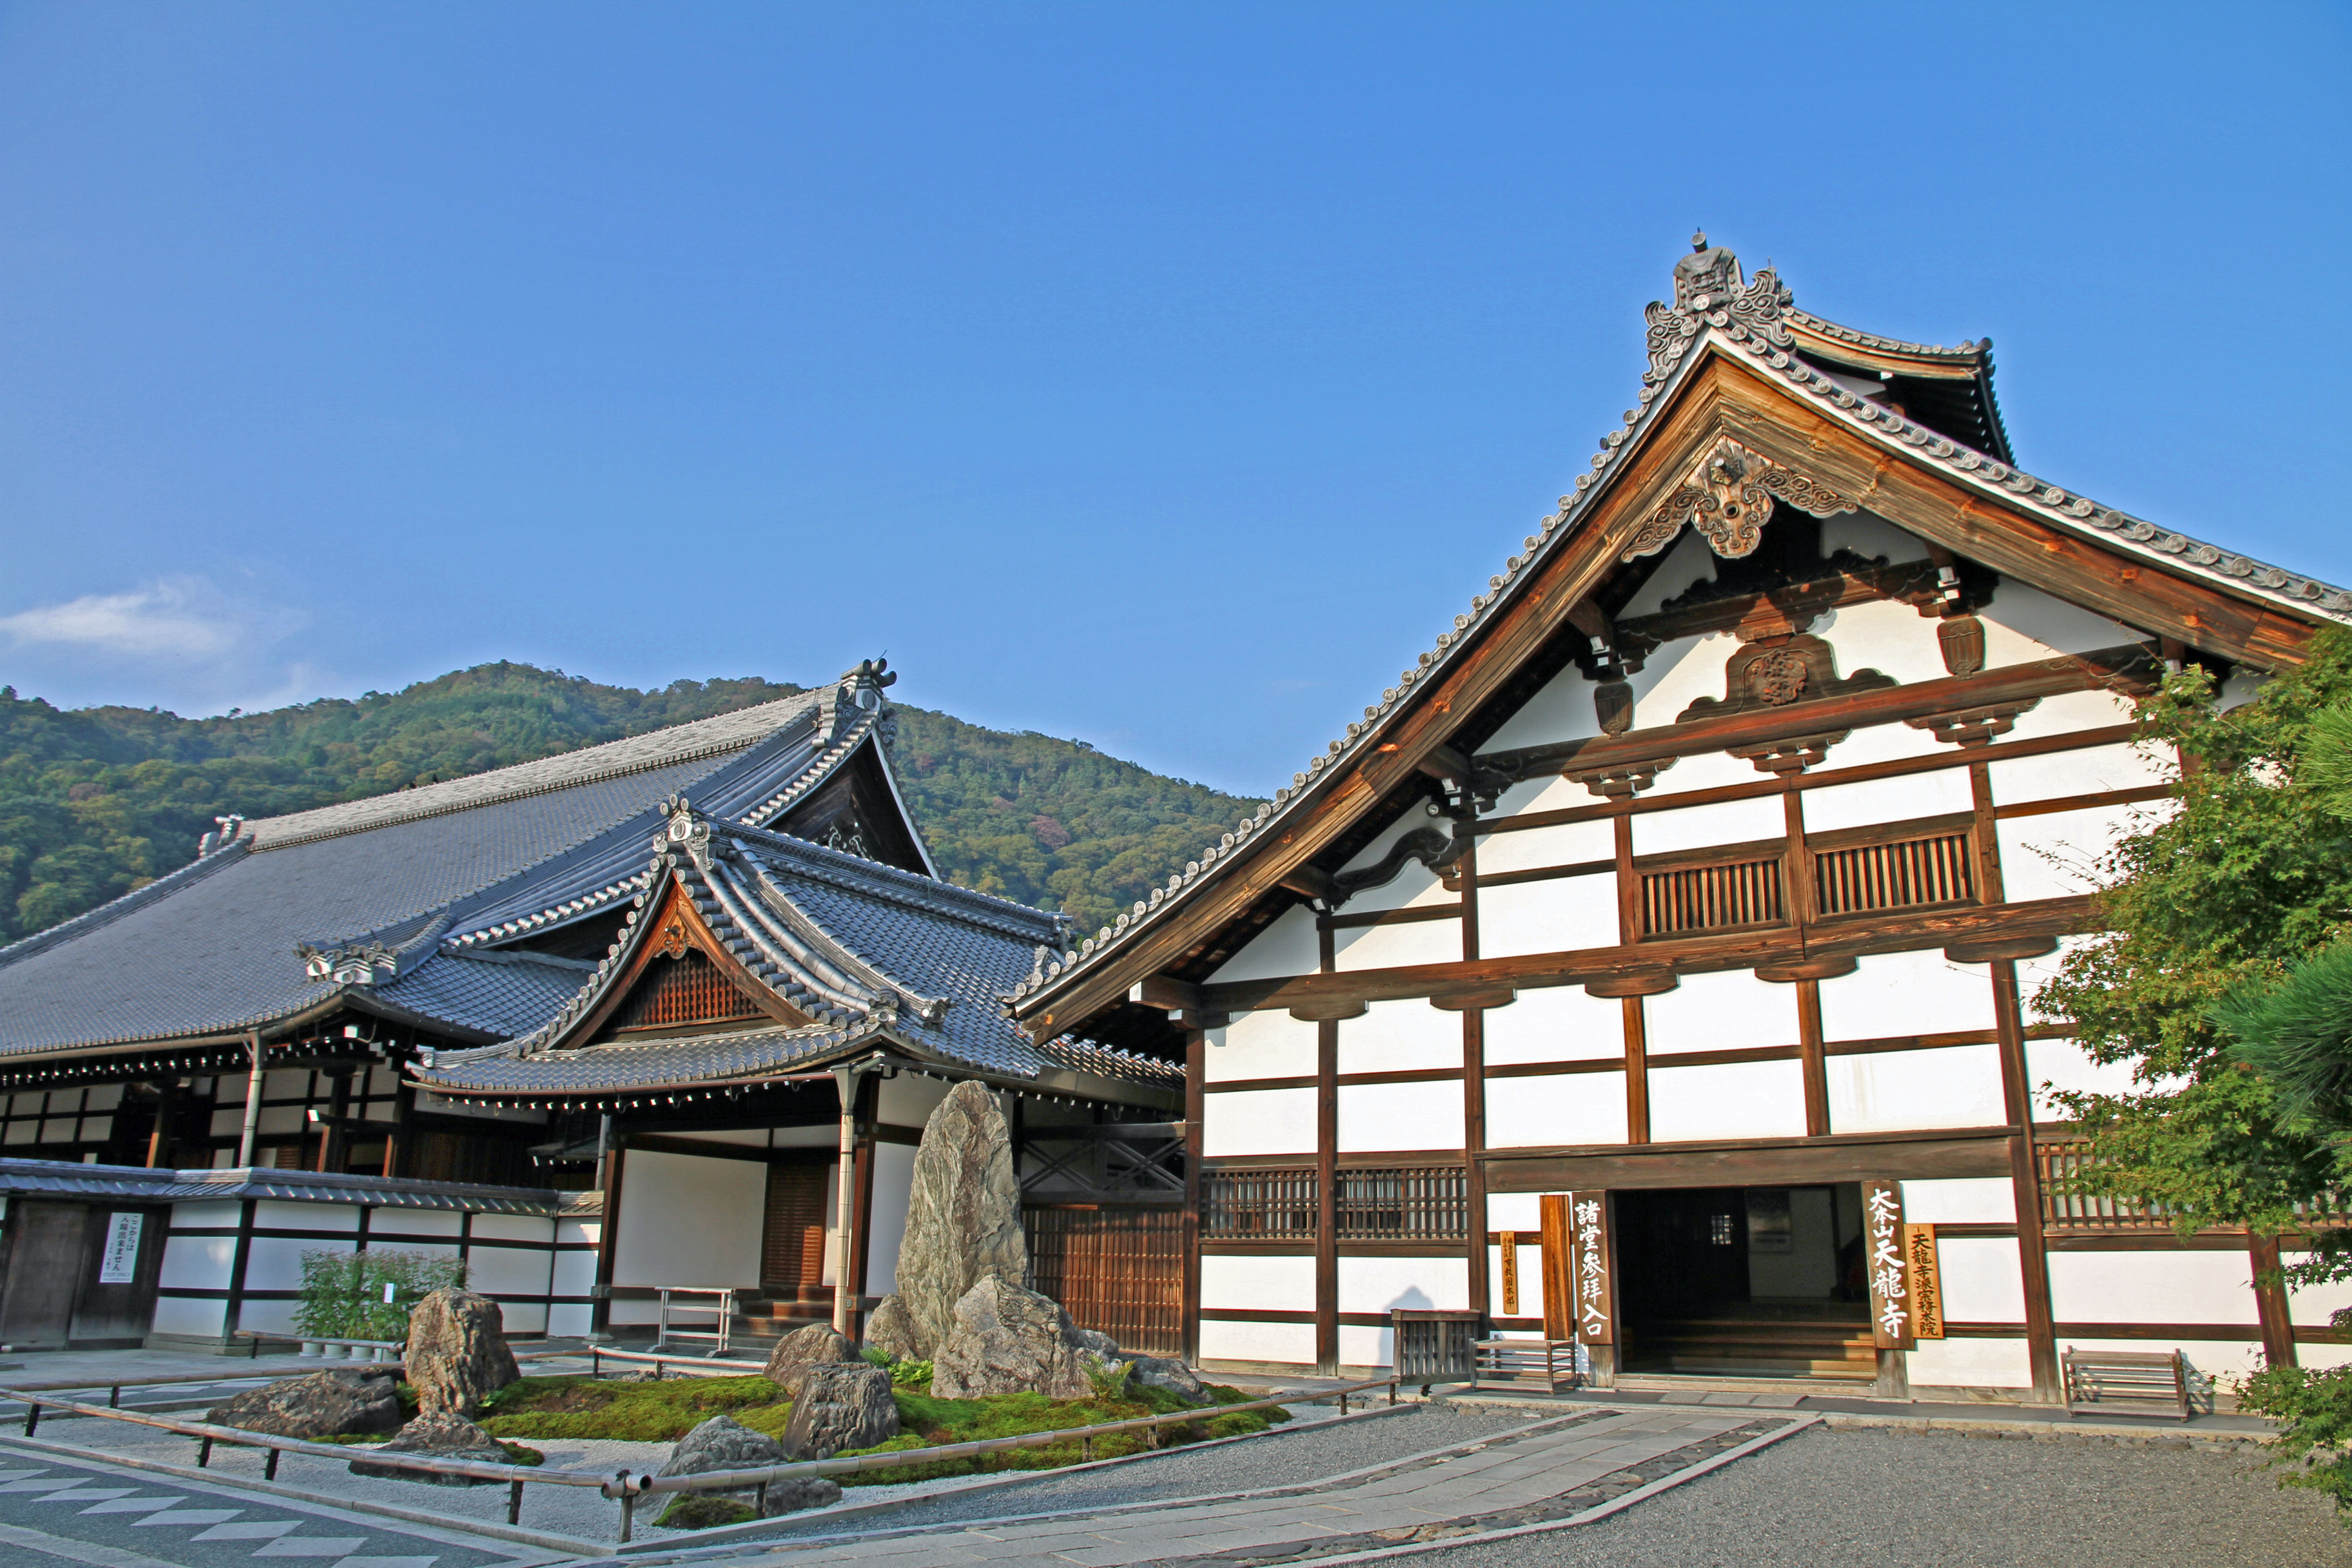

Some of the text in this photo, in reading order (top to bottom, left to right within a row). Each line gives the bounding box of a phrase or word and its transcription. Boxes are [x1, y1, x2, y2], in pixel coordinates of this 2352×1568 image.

[113, 1217, 129, 1271] 入場出来ません
[126, 1215, 138, 1251] ここからは
[1868, 1188, 1908, 1338] 大本山天龍寺
[1910, 1233, 1939, 1337] 天龍寺派宗務本院
